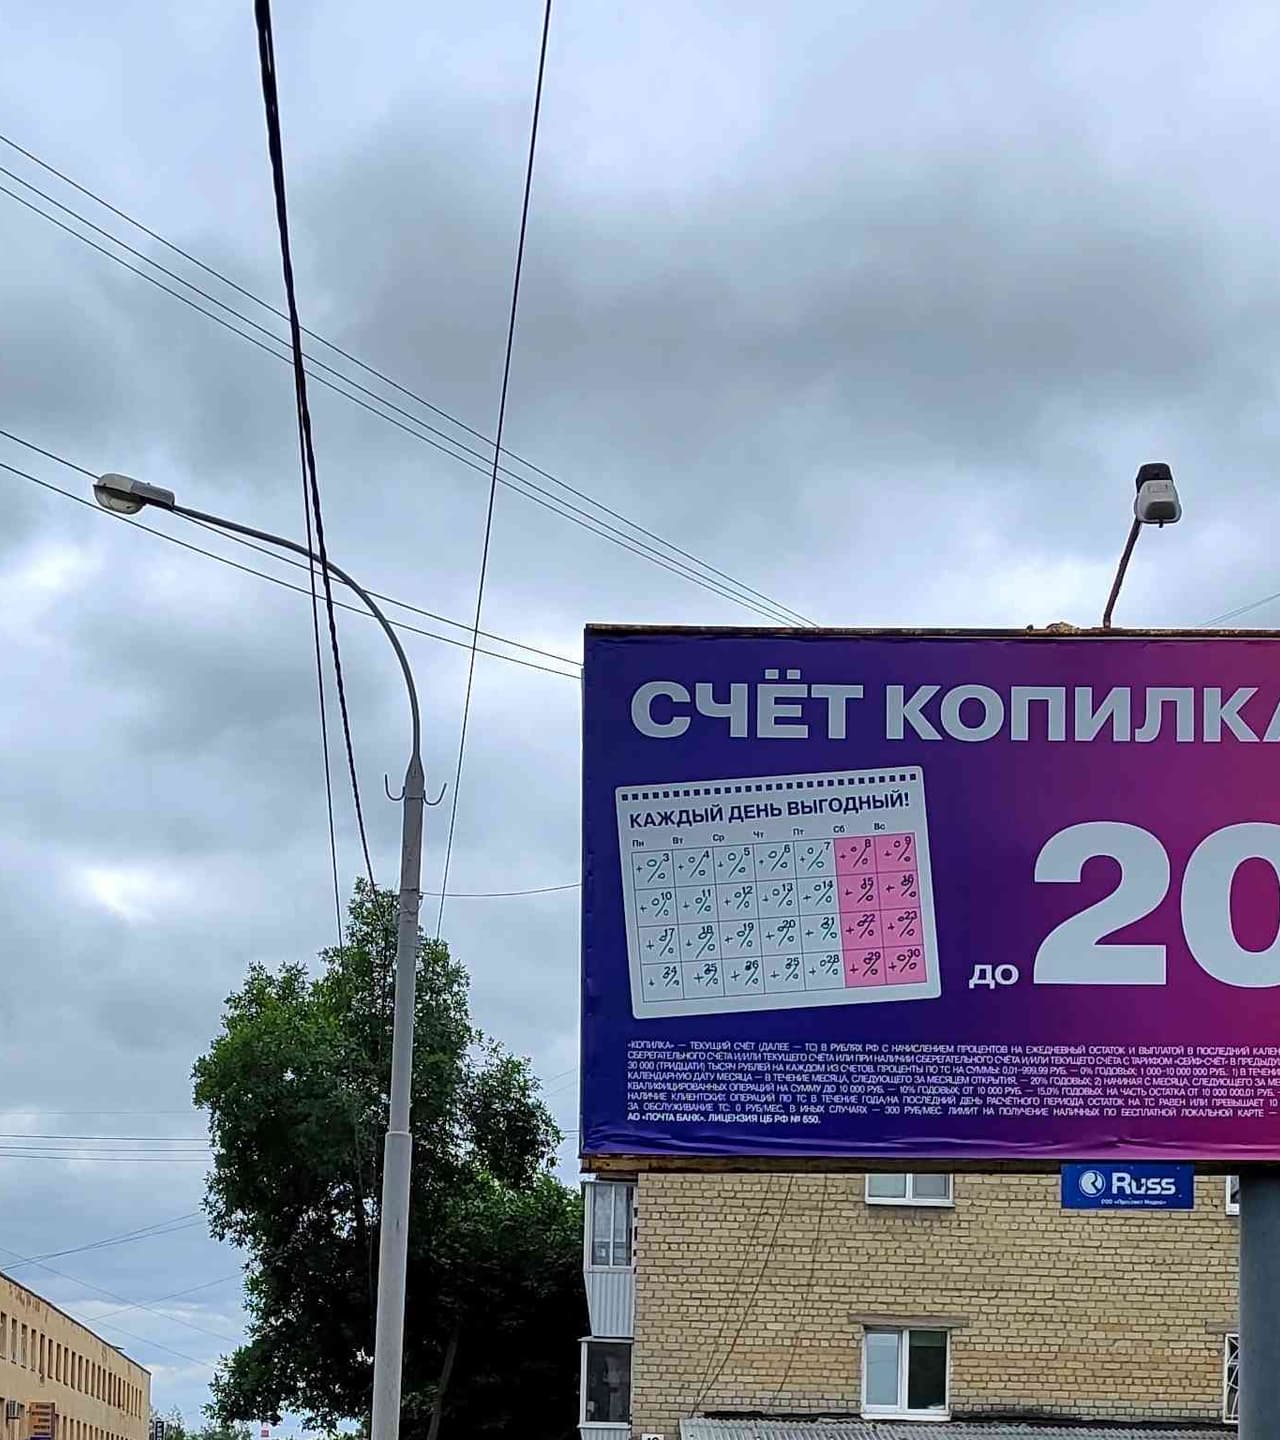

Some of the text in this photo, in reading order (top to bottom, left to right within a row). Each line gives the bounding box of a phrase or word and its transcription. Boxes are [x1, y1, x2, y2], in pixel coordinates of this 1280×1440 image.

[631, 669, 864, 739] СЧЁТ
[630, 790, 910, 829] КАЖДЫЙ ДЕНЬ ВЫГОДНЫЙ!
[713, 834, 724, 842] Ср
[793, 828, 804, 836] Пт
[833, 825, 845, 833] Сб
[874, 823, 885, 831] Вс
[663, 853, 670, 862] 3
[743, 847, 750, 856] 5
[784, 844, 791, 854] 6
[824, 842, 831, 851] 7
[864, 839, 871, 848] 8
[661, 891, 672, 901] 10
[702, 889, 711, 898] 11
[742, 886, 753, 895] 12
[782, 883, 793, 892] 13
[822, 880, 833, 889] 14
[743, 922, 754, 931] 19
[783, 919, 796, 929] 20
[863, 914, 875, 923] 22
[904, 911, 917, 920] 23
[826, 954, 840, 964] 28
[868, 951, 881, 961] 29
[907, 948, 920, 958] 30
[690, 1042, 730, 1051] ТЕКУЩИЙ
[733, 1042, 754, 1051] СЧЁТ
[758, 1042, 789, 1051] (ДАЛЕЕ
[820, 1043, 827, 1052] В
[830, 1043, 862, 1052] РУБЛЯХ
[865, 1043, 878, 1052] РФ
[881, 1043, 888, 1052] С
[891, 1043, 954, 1053] НАЧИСЛЕНИЕМ
[956, 1044, 1008, 1054] ПРОЦЕНТОВ
[1010, 1045, 1022, 1054] НА
[1025, 1045, 1085, 1054] ЕЖЕДНЕВНЫЙ
[1088, 1045, 1125, 1055] ОСТАТОК
[1128, 1046, 1135, 1055] И
[1138, 1046, 1184, 1055] ВЫПЛАТОЙ
[1186, 1046, 1193, 1055] В
[1196, 1046, 1249, 1055] ПОСЛЕДНИЙ
[627, 1092, 666, 1102] НАЛИЧИЕ
[729, 1093, 775, 1102] ОПЕРАЦИЙ
[778, 1093, 792, 1102] ПО
[796, 1093, 806, 1103] ТС
[810, 1094, 817, 1103] В
[822, 1094, 858, 1103] ТЕЧЕНИЕ
[902, 1095, 956, 1104] ПОСЛЕДНИЙ
[959, 1096, 982, 1105] ДЕНЬ
[986, 1096, 1040, 1106] РАСЧЁТНОГО
[1043, 1097, 1083, 1106] ПЕРИОДА
[1087, 1097, 1124, 1106] ОСТАТОК
[1128, 1097, 1140, 1106] НА
[1144, 1097, 1154, 1106] ТС
[1158, 1097, 1186, 1106] РАВЕН
[1189, 1097, 1208, 1107] ИЛИ
[1211, 1098, 1263, 1107] ПРЕВЫШАЕТ
[1269, 1098, 1278, 1107] 10
[627, 1103, 638, 1112] ЗА
[642, 1103, 713, 1112] ОБСЛУЖИВАНИЕ
[735, 1104, 741, 1113] 0
[789, 1104, 795, 1113] В
[799, 1104, 824, 1113] ИНЫХ
[828, 1104, 867, 1114] СЛУЧАЯХ
[884, 1105, 900, 1114] 300
[948, 1106, 977, 1115] ЛИМИТ
[982, 1106, 994, 1115] НА
[998, 1106, 1048, 1116] ПОЛУЧЕНИЕ
[1052, 1107, 1099, 1116] НАЛИЧНЫХ
[1103, 1107, 1116, 1116] ПО
[1120, 1107, 1176, 1117] БЕСПЛАТНОЙ
[1180, 1108, 1233, 1117] ЛОКАЛЬНОЙ
[1237, 1108, 1264, 1118] КАРТЕ
[627, 1112, 640, 1122] АО
[708, 1113, 757, 1123] ЛИЦЕНЗИЯ
[759, 1114, 772, 1123] ЦБ
[774, 1114, 788, 1124] РФ
[1112, 1172, 1176, 1195] Russ
